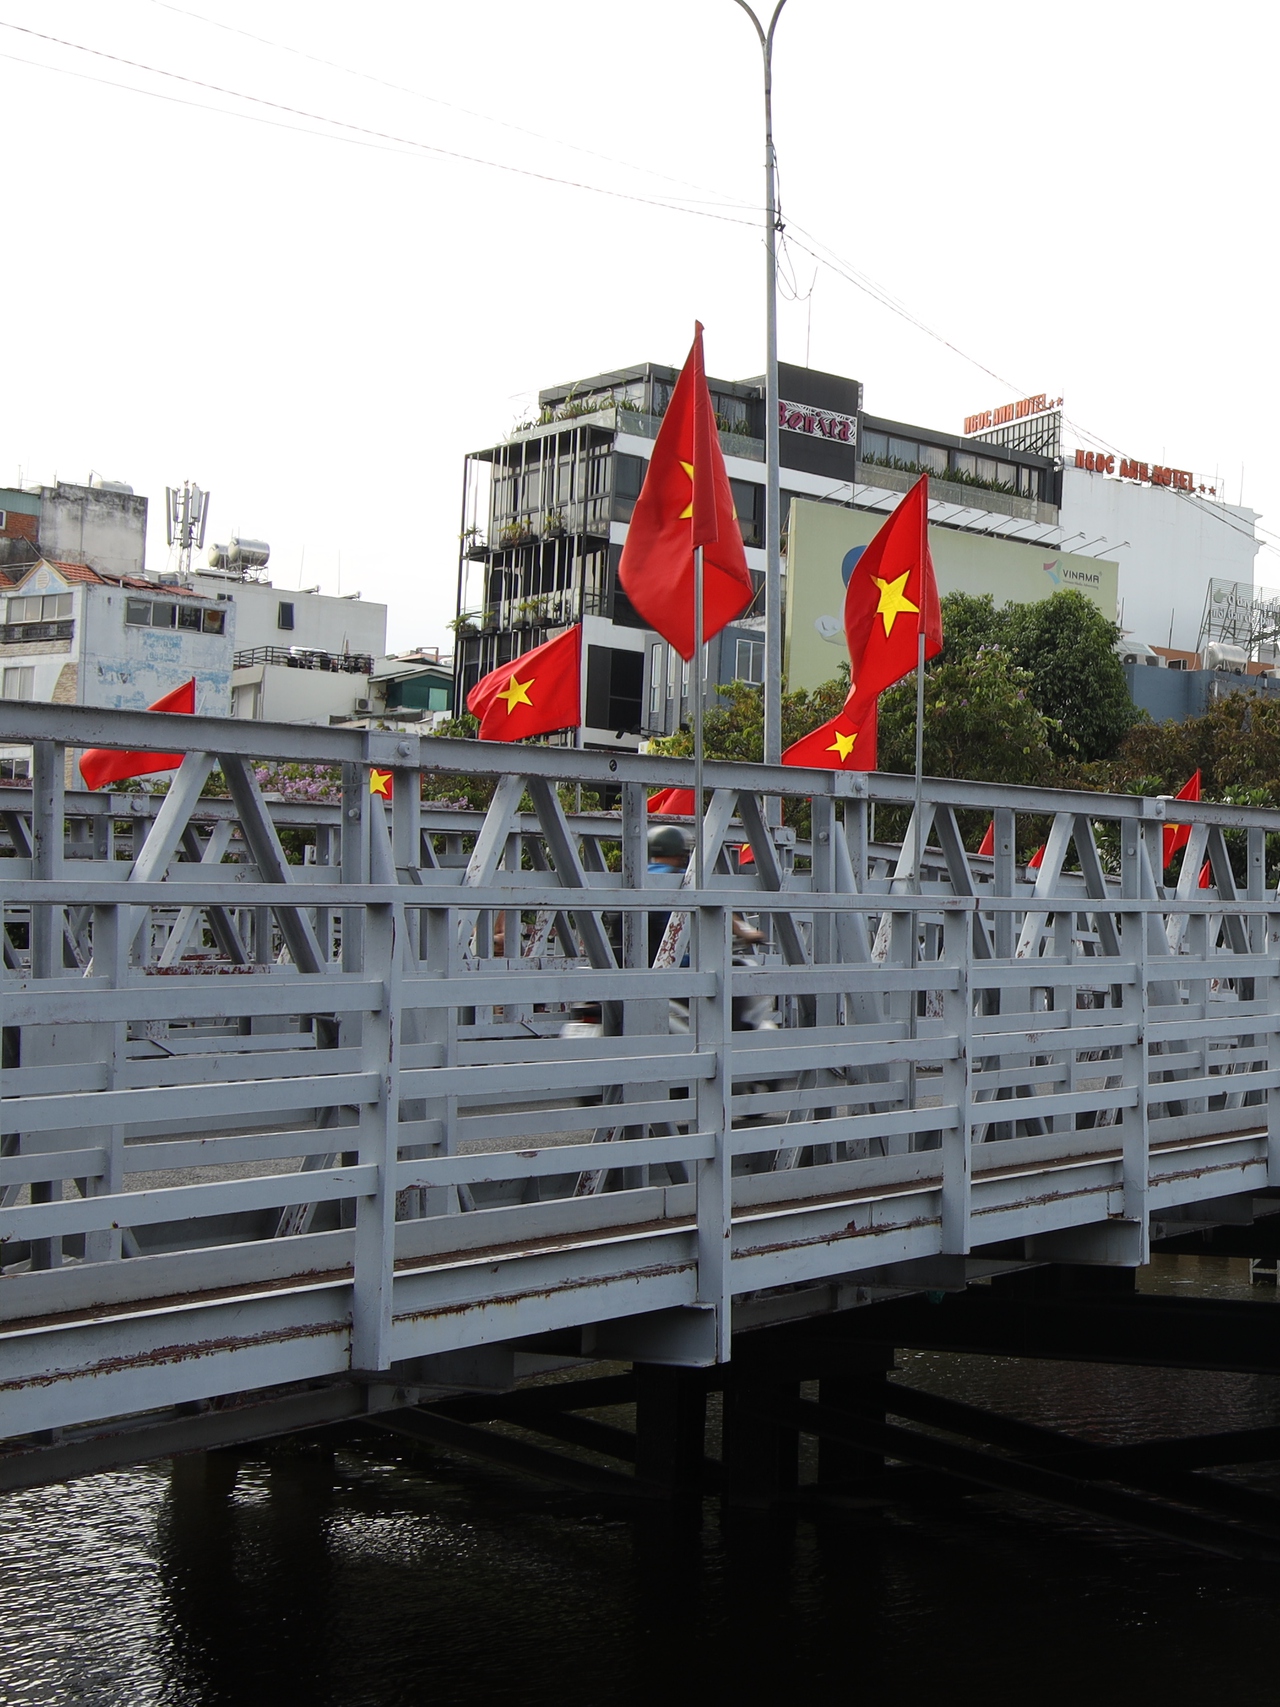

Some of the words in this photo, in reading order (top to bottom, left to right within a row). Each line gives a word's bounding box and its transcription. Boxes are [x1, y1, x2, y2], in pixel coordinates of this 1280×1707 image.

[778, 401, 850, 441] Bonita
[993, 403, 1015, 426] ANH
[1015, 393, 1047, 419] HOTEL
[1120, 458, 1149, 482] ANH
[1152, 464, 1196, 492] HOTEL
[1062, 568, 1100, 584] VINAMA
